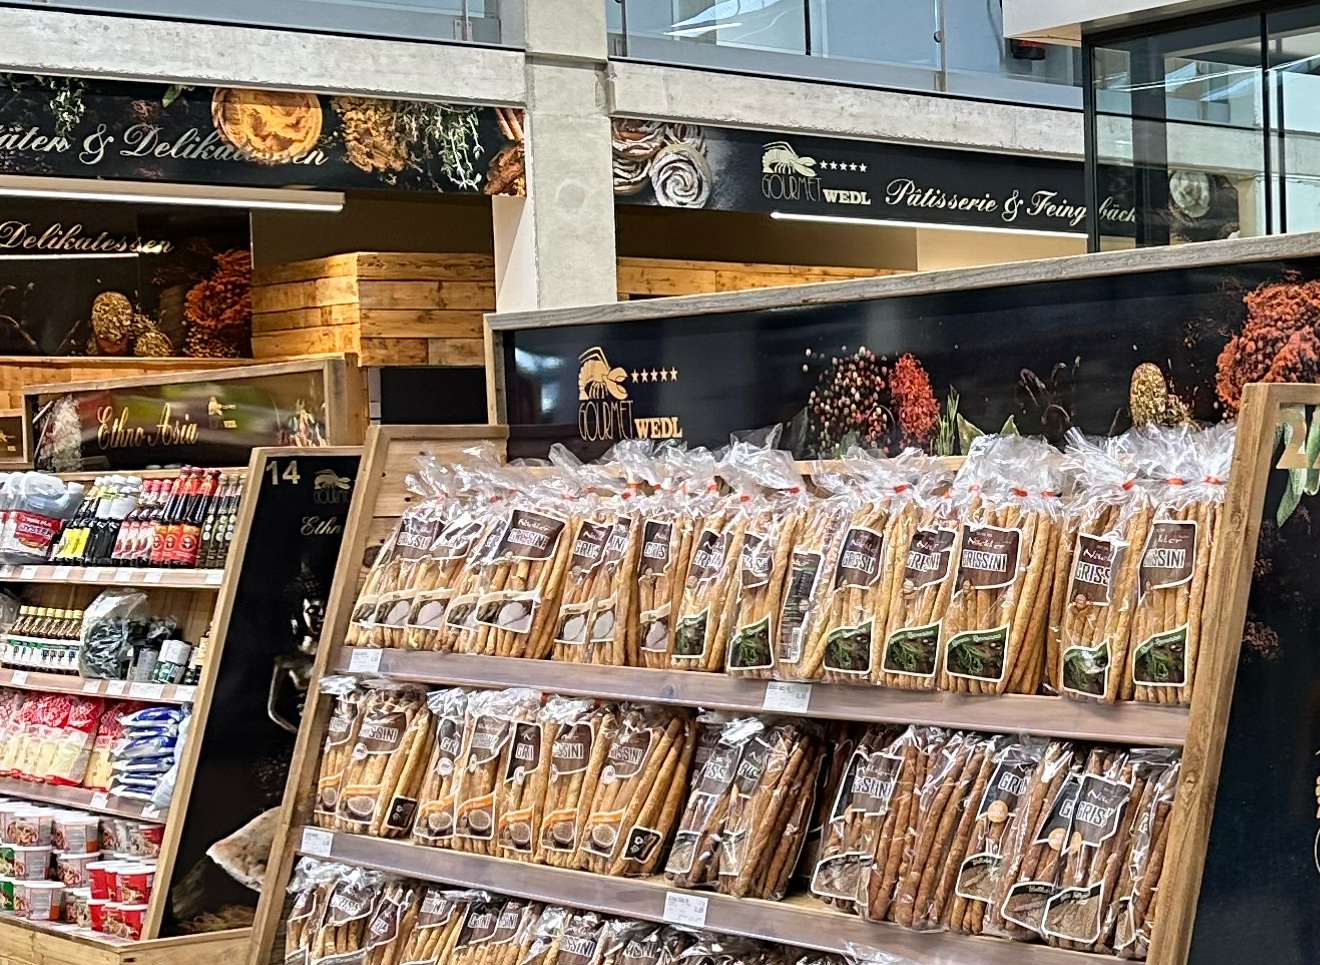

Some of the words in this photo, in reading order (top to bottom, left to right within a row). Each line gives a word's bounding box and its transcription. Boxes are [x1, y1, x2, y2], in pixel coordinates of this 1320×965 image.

[0, 124, 71, 153] äten
[79, 123, 114, 166] &
[121, 123, 329, 166] Delikaten
[761, 174, 822, 201] GOURMET
[822, 188, 871, 205] WEDL
[885, 178, 998, 212] Pâtisserie
[1002, 189, 1024, 222] &
[1026, 190, 1136, 227] Feingbäck
[0, 220, 174, 254] Delikatessen
[97, 405, 147, 449] Ethno
[148, 403, 199, 446] Asia
[578, 400, 633, 441] GOURMET
[633, 416, 683, 440] WEDL
[265, 460, 301, 487] 14
[300, 515, 343, 537] Ethn
